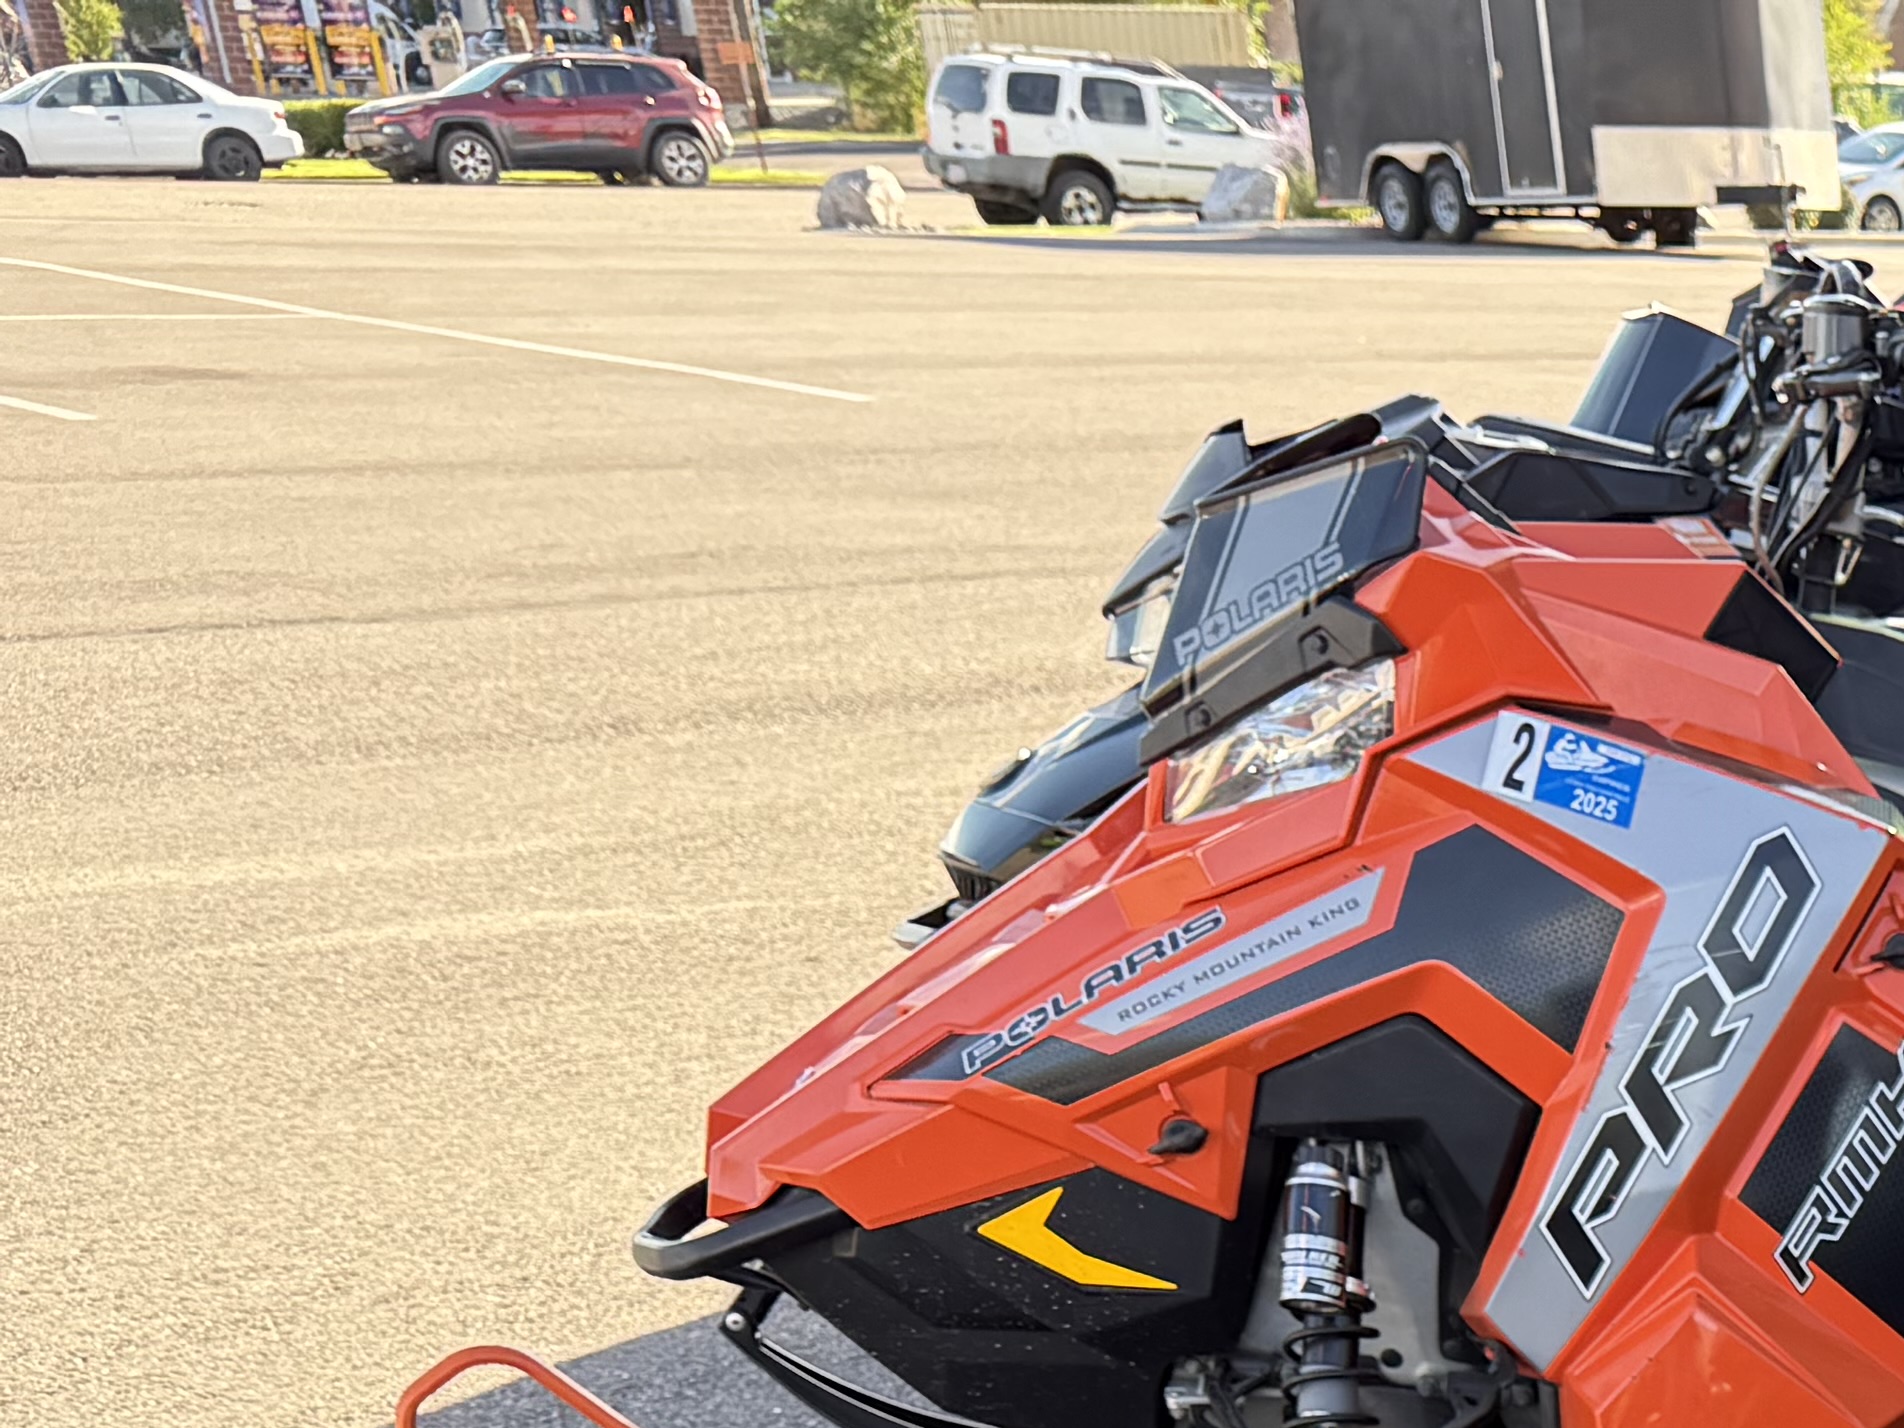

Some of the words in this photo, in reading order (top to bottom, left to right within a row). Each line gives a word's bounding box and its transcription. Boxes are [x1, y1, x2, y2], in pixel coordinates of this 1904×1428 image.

[1172, 542, 1344, 667] POLARIS
[1502, 722, 1536, 792] 2
[1570, 788, 1619, 822] 2025
[962, 905, 1227, 1075] POLARIS
[1116, 981, 1187, 1023] ROCKY
[1192, 923, 1303, 984] MOUNTAIN
[1306, 896, 1362, 928] KING
[1540, 826, 1822, 1300] PRO
